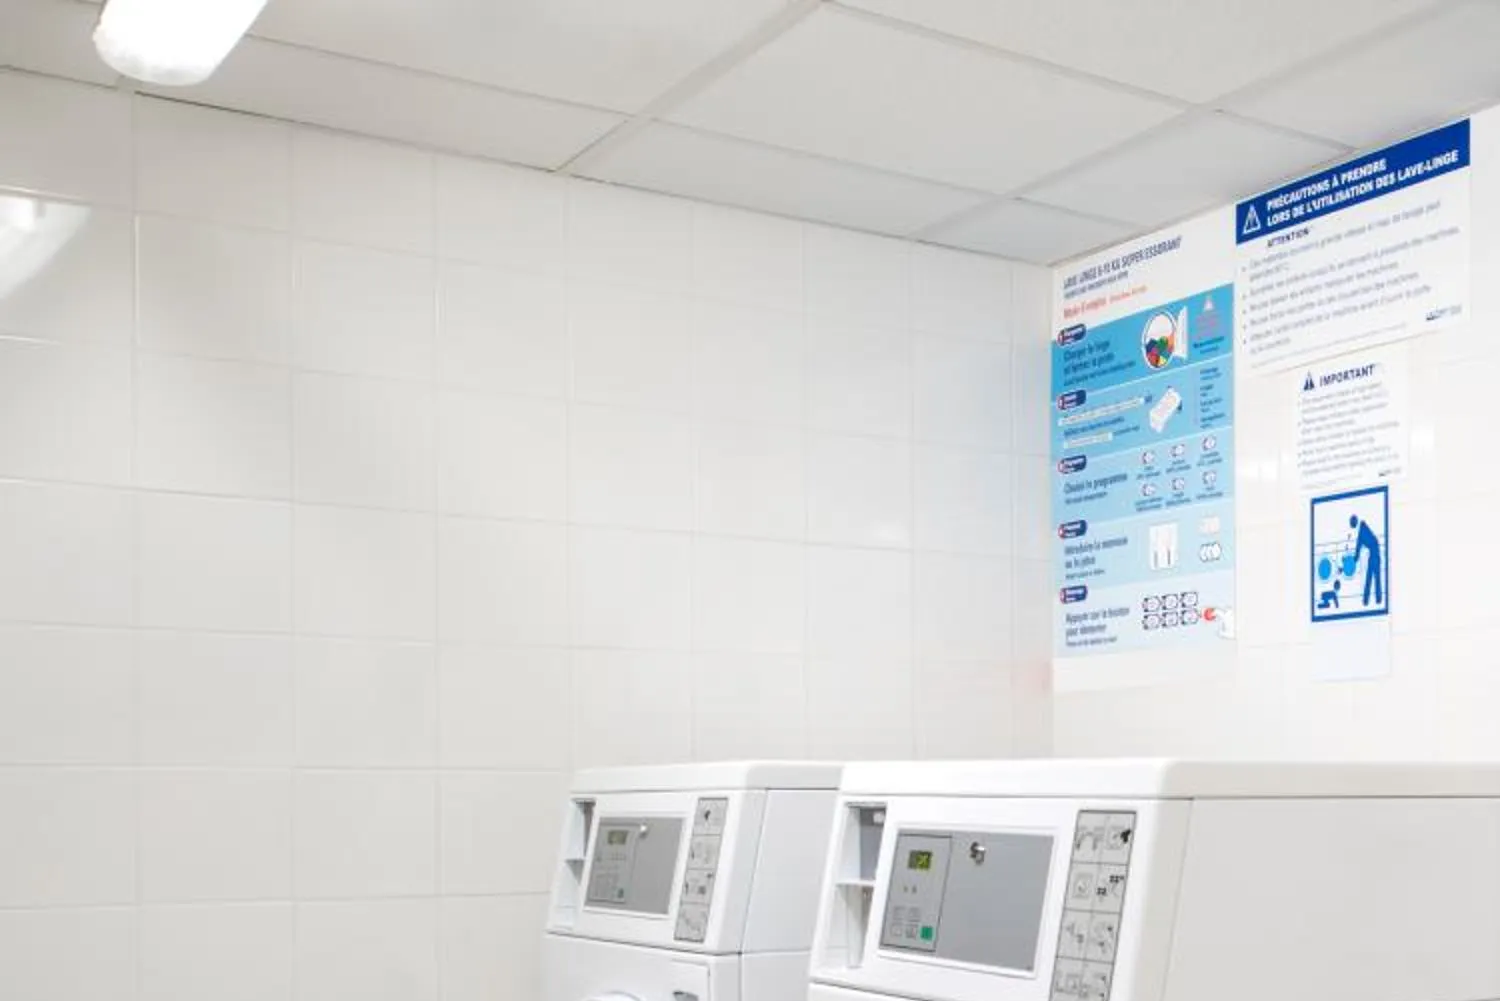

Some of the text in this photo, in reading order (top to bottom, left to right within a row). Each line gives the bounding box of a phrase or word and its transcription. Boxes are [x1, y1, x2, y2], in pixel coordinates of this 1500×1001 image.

[1267, 181, 1331, 211] PRÉCAUTIONS
[1340, 158, 1387, 184] PRENDRE
[1267, 209, 1290, 227] LORS
[1293, 204, 1305, 219] DE
[1376, 174, 1396, 190] DES
[1398, 149, 1459, 180] LAVE-LINGE
[1320, 363, 1375, 387] IMPORTANT
